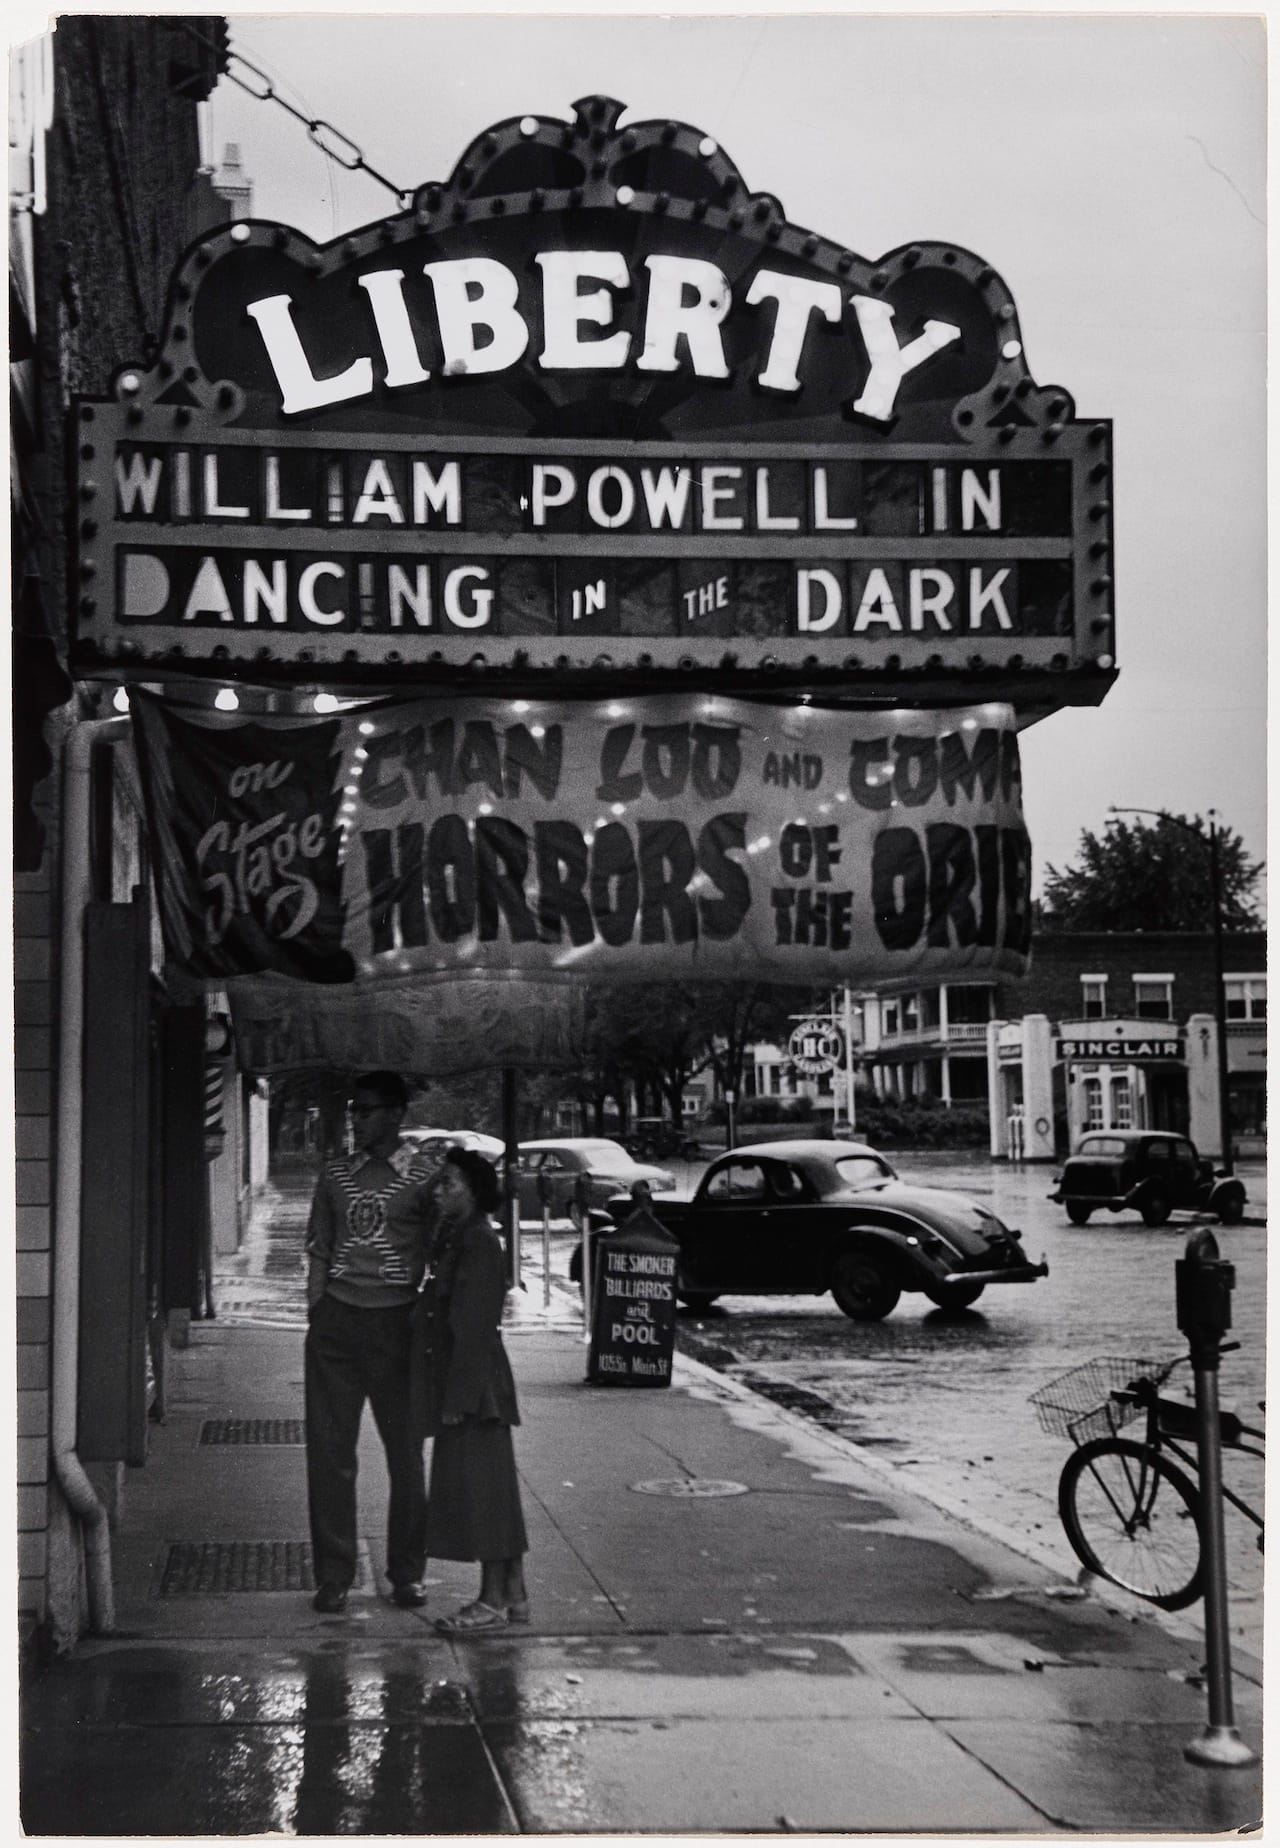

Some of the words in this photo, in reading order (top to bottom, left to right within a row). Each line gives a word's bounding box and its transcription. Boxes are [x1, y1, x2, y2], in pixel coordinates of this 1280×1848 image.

[247, 250, 961, 420] LIBERTY
[115, 451, 462, 525] WILLIAM
[532, 464, 858, 531] POWELL
[933, 467, 1001, 531] IN
[122, 553, 495, 629] DANCING
[571, 579, 607, 620] IN
[683, 576, 729, 620] THE
[796, 567, 1014, 632] DARK
[359, 718, 563, 809] CHAN
[595, 721, 743, 802] LOO
[762, 751, 823, 790] AND
[196, 812, 326, 944] Stage
[359, 811, 751, 956] HORRORS
[779, 823, 842, 883] OF
[770, 886, 854, 951] THE
[1062, 1041, 1178, 1056] SINCLAIR
[604, 1276, 673, 1300] BILLIARDS
[608, 1253, 628, 1272] THE
[629, 1255, 676, 1276] SMOKER
[611, 1323, 661, 1346] POOL
